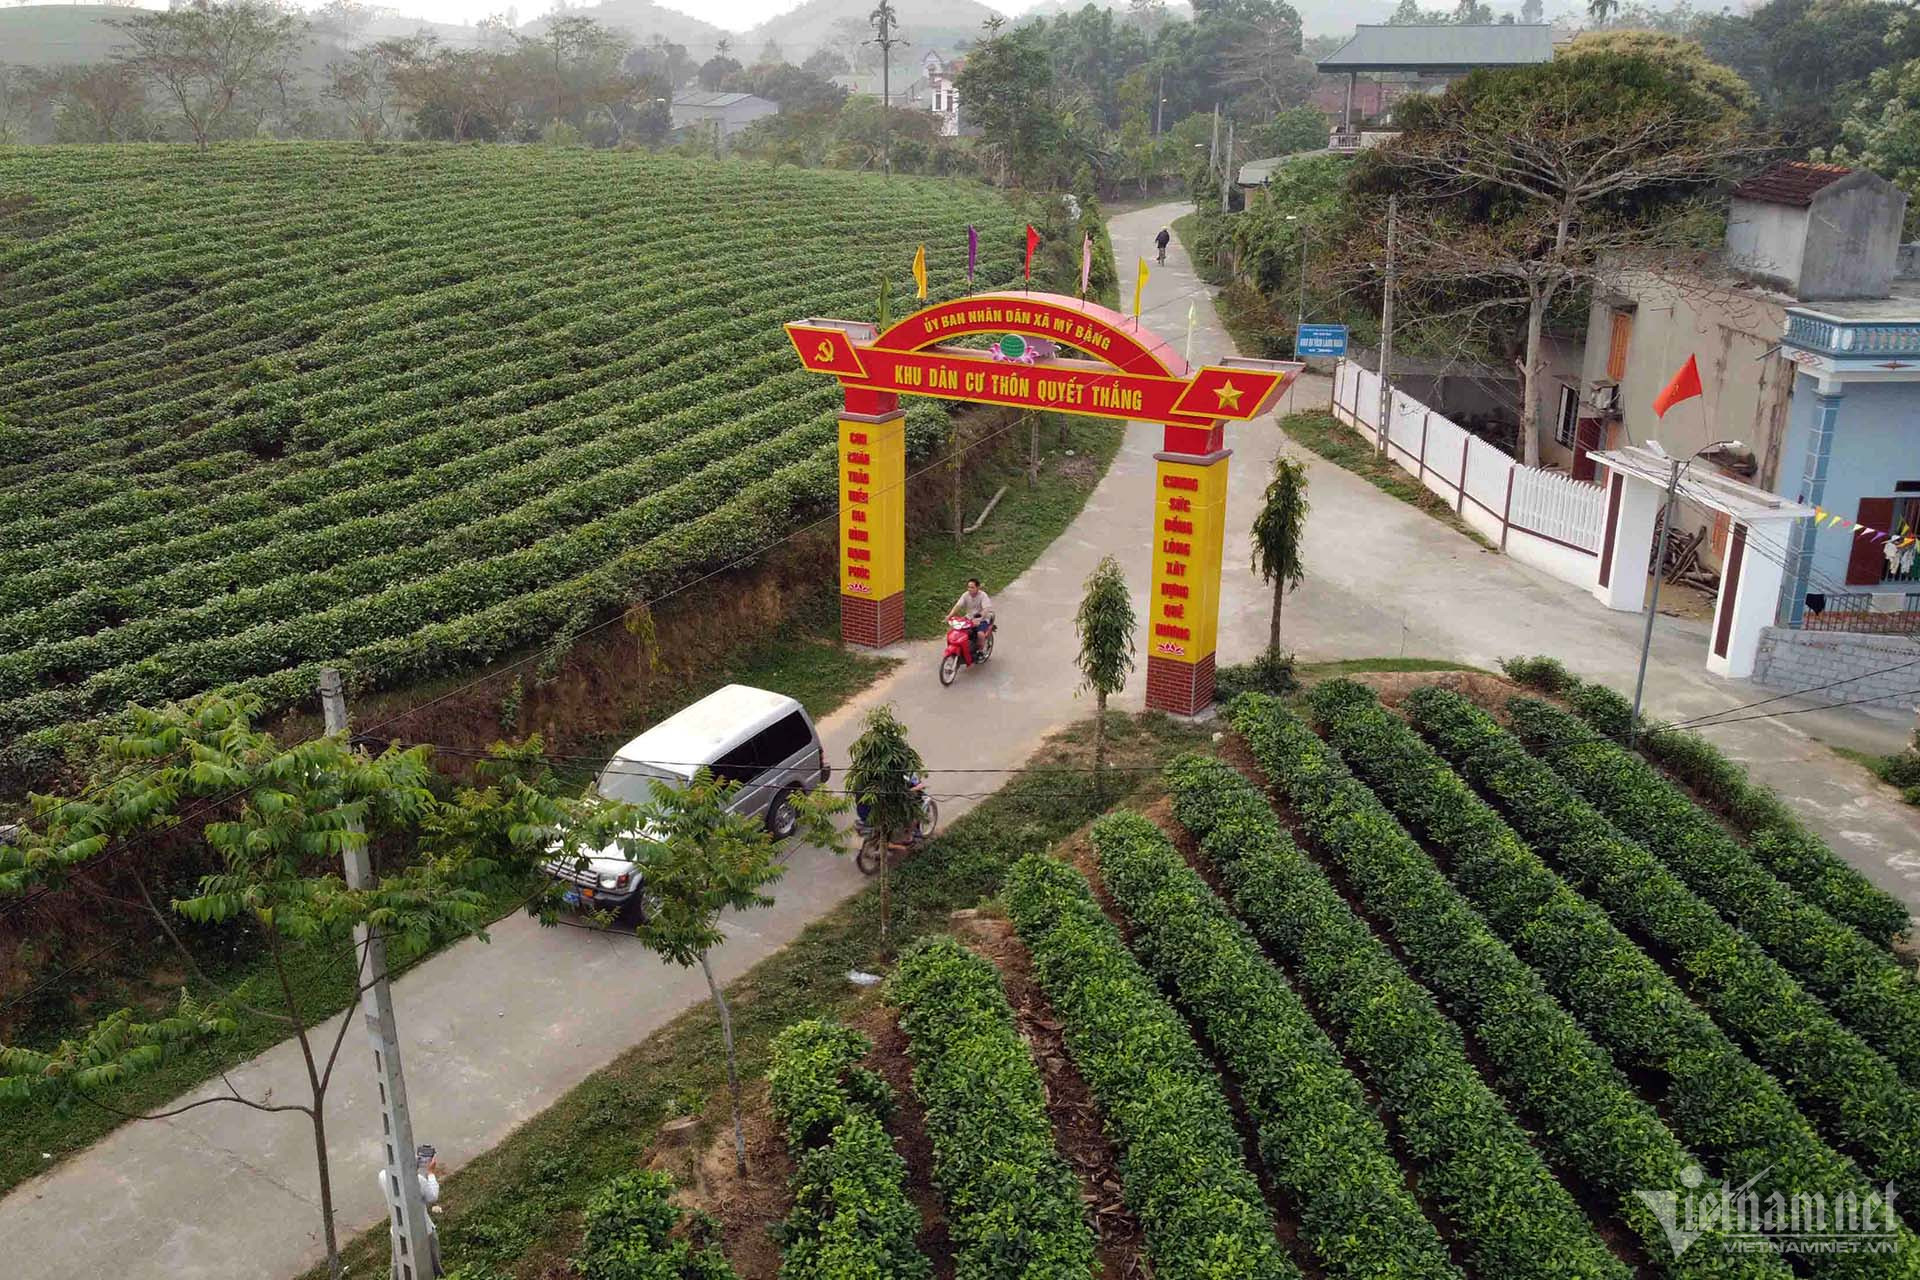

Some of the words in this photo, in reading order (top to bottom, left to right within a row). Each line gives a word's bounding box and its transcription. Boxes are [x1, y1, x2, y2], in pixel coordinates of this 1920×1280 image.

[941, 312, 966, 328] BAN
[968, 307, 1002, 323] NHÂN
[1006, 308, 1031, 324] DÂN
[1033, 312, 1050, 328] XÃ
[1053, 318, 1073, 334] MỸ
[895, 364, 922, 386] KHU
[929, 365, 958, 390] DÂN
[966, 371, 985, 393] CƯ
[992, 372, 1029, 398] THÔN
[1038, 376, 1083, 404] QUYẾT
[1092, 380, 1142, 411] THẮNG
[1166, 560, 1187, 577] XÂY
